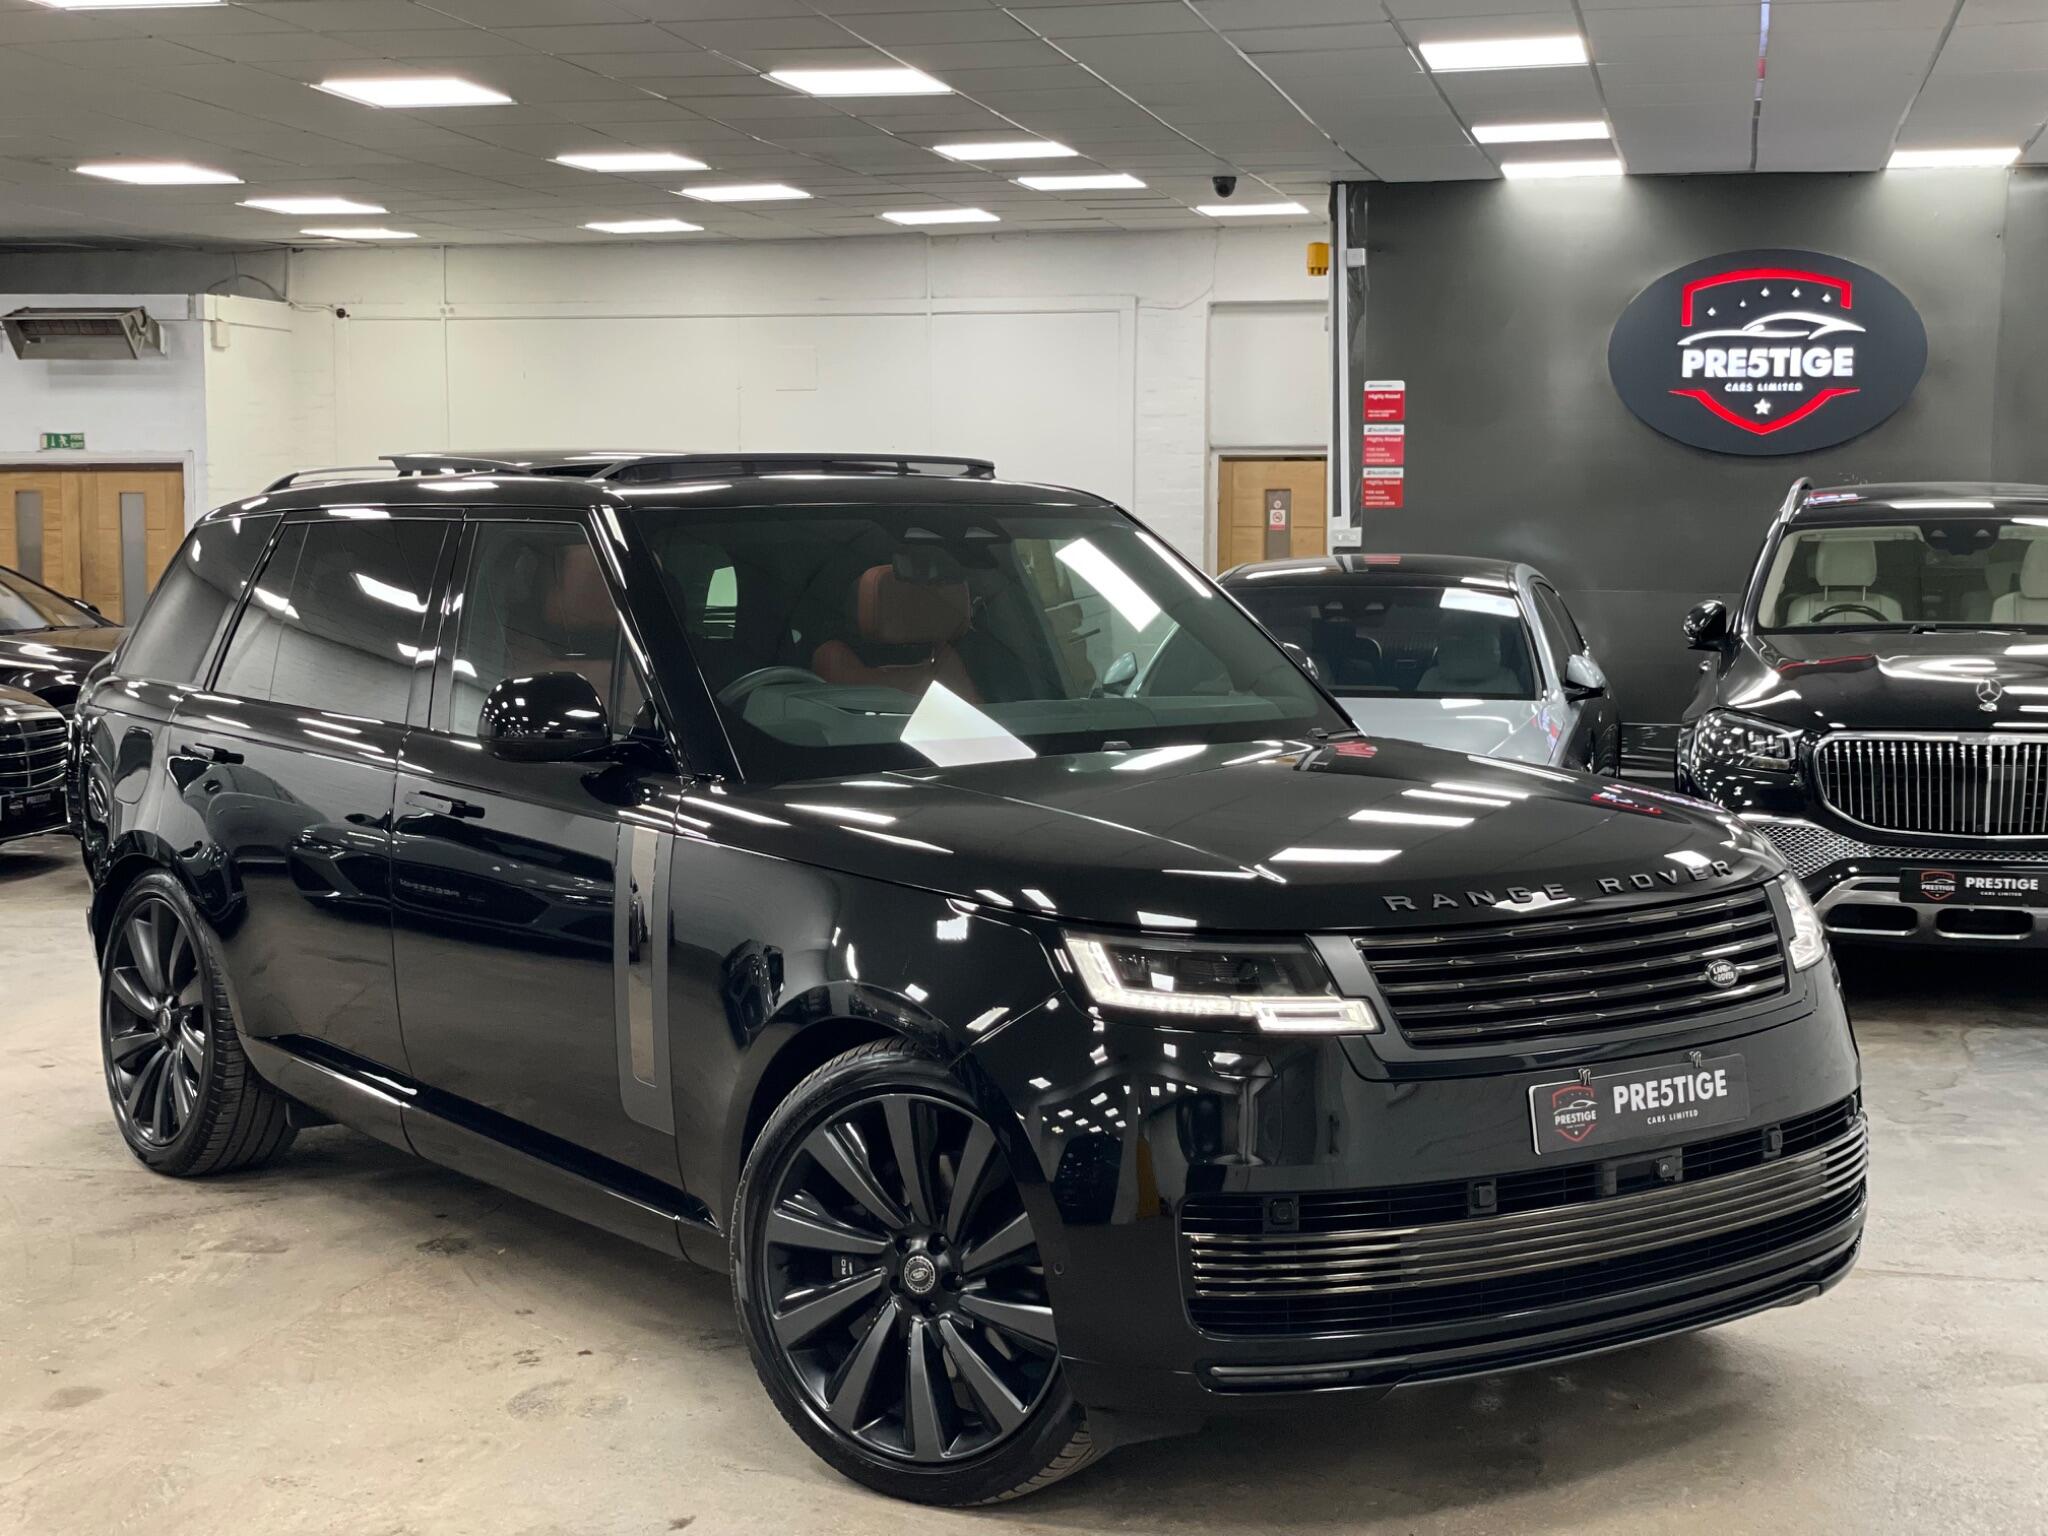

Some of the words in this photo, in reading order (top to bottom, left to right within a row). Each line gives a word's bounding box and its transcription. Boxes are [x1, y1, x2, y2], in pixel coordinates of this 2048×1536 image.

[1724, 382, 1753, 392] CARS
[1756, 382, 1804, 392] LIMITED
[1382, 883, 1569, 911] RANGE
[1597, 860, 1733, 893] ROVER
[1647, 1113, 1666, 1125] CARS
[1669, 1109, 1699, 1121] LIMITED
